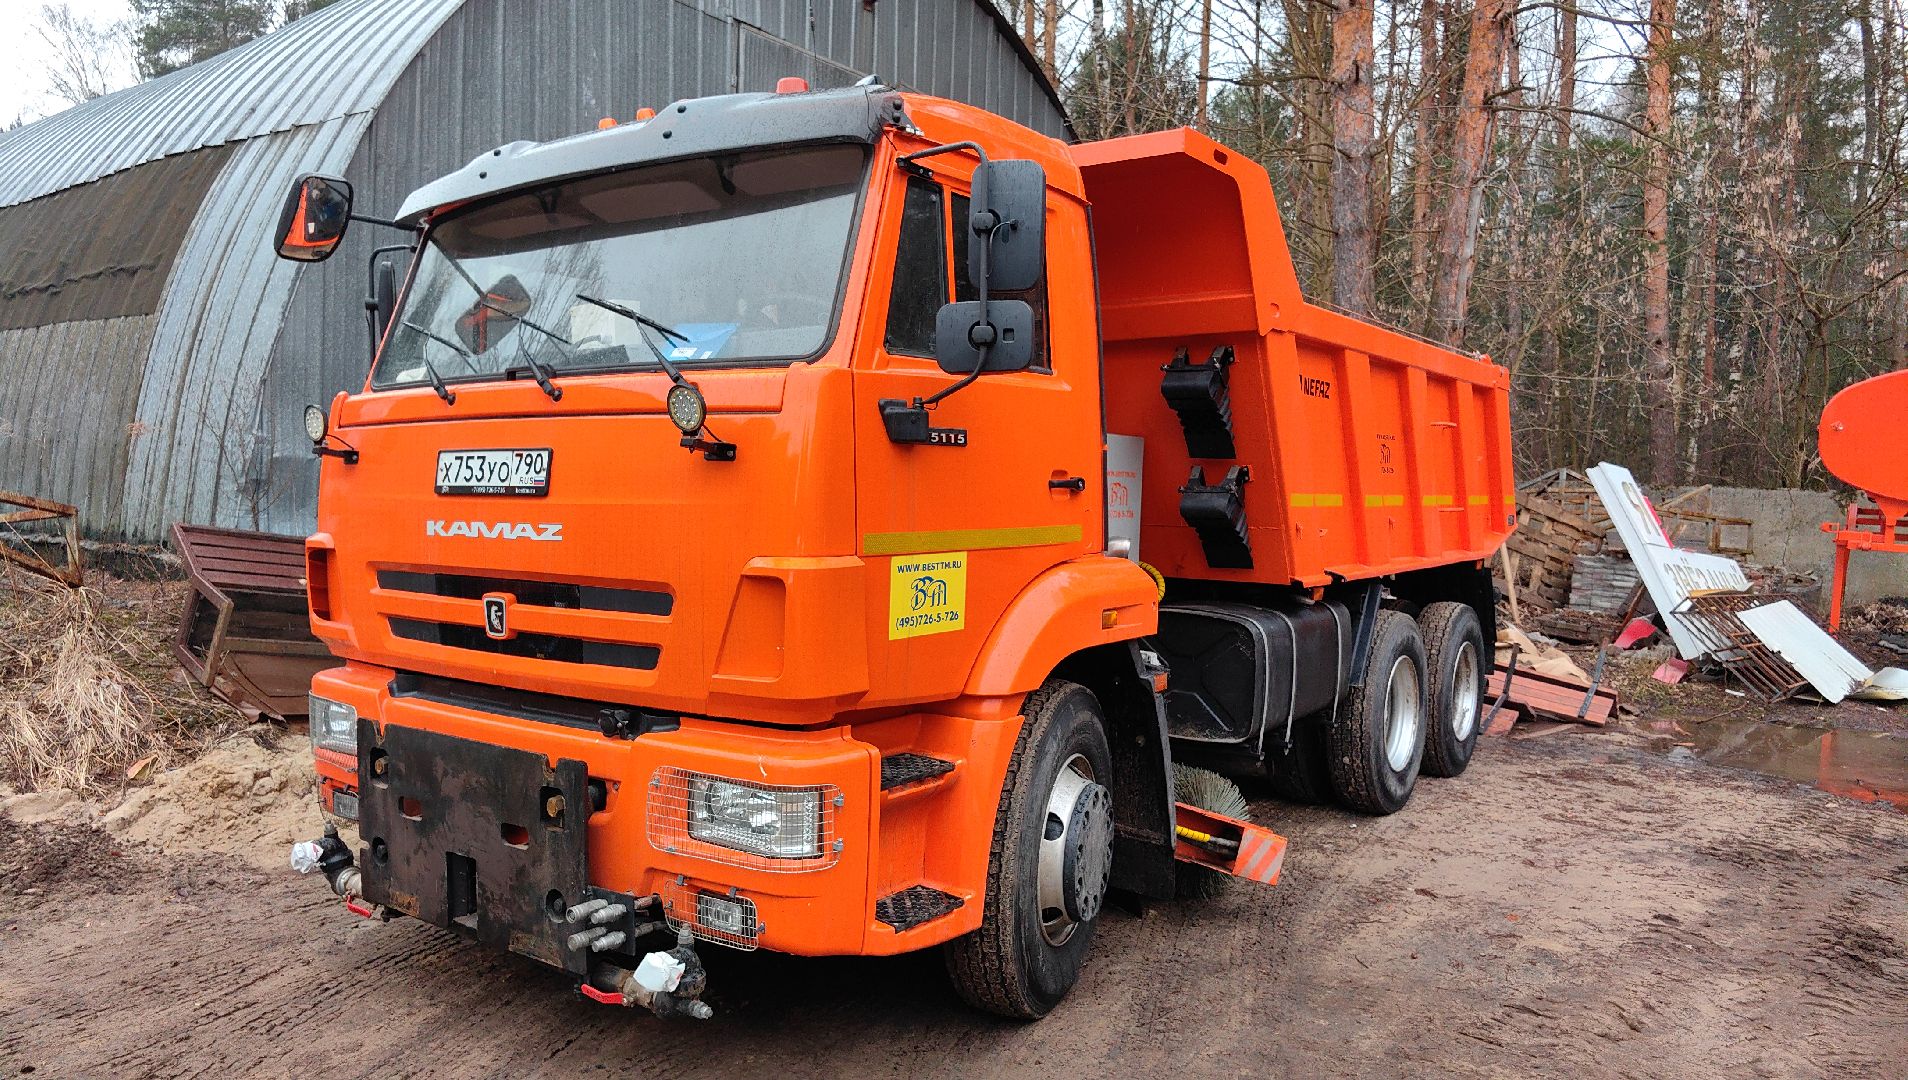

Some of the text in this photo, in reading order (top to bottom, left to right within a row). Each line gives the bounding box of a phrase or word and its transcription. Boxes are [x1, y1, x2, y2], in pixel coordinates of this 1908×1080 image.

[1304, 377, 1330, 399] NEFAZ
[515, 453, 544, 475] 790
[519, 476, 534, 485] RUS
[426, 520, 563, 541] KAMAZ
[895, 611, 959, 630] (495)726-5-726
